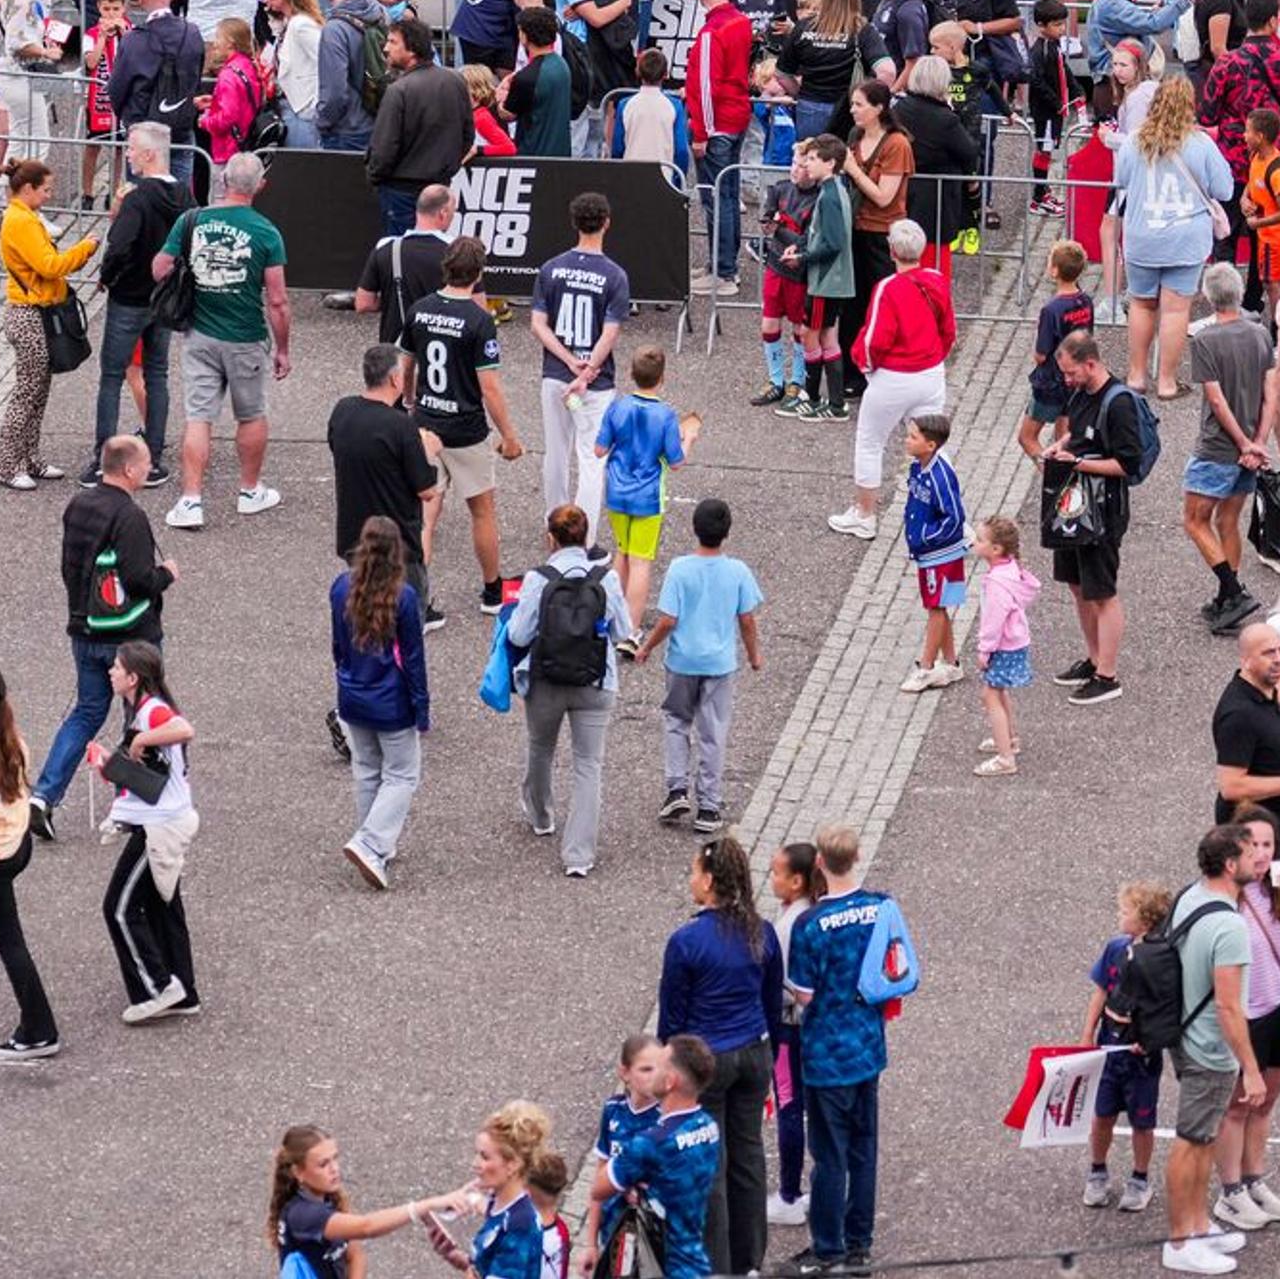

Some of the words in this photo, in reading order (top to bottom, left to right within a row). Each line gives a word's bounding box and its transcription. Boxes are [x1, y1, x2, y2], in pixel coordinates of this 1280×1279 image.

[483, 265, 541, 275] ROTTERDA
[555, 292, 592, 348] 40
[426, 340, 448, 394] 8
